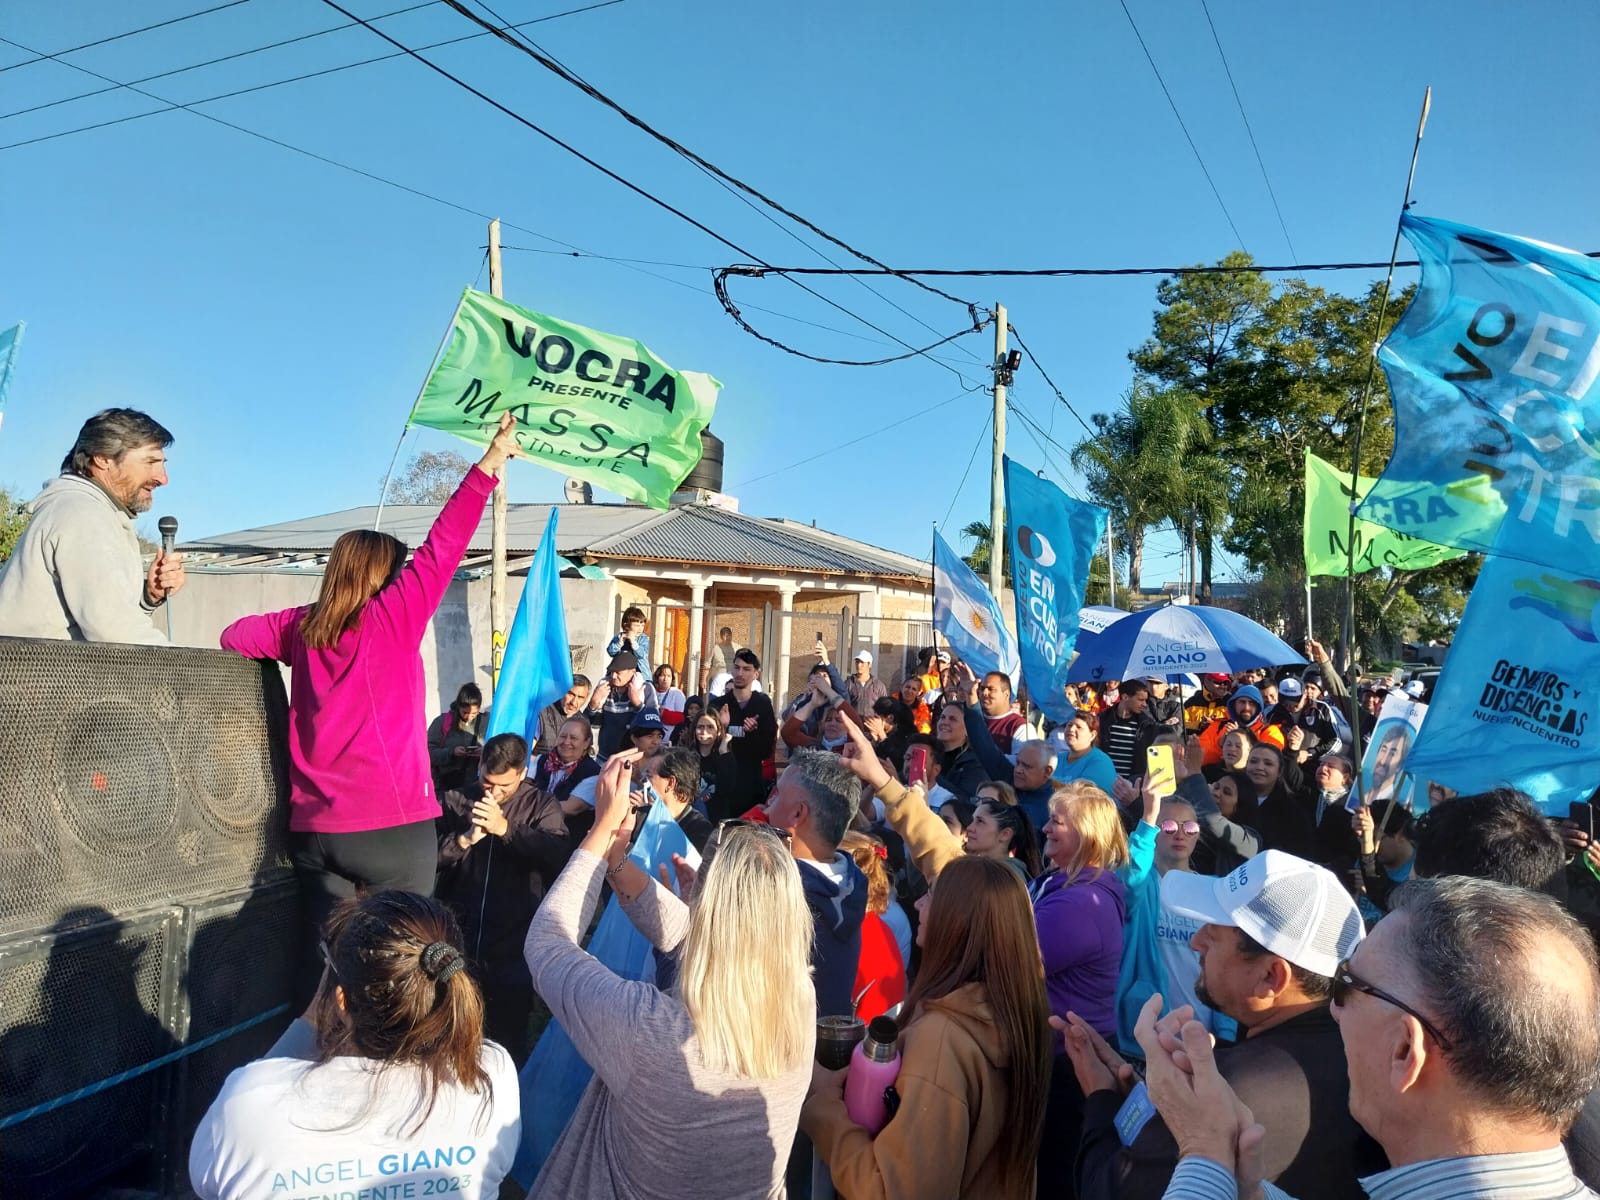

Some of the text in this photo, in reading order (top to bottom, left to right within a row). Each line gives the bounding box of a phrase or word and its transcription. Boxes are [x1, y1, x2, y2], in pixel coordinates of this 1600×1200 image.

[501, 317, 676, 414] VOCRA
[527, 375, 633, 410] PRESENTE
[455, 378, 650, 468] MASSA
[1029, 568, 1055, 605] EN
[1029, 619, 1057, 667] TRO
[1142, 640, 1205, 652] ANGEL
[1143, 652, 1207, 665] GIANO
[271, 1145, 476, 1192] ANGEL GIANO
[422, 1173, 473, 1196] 2023
